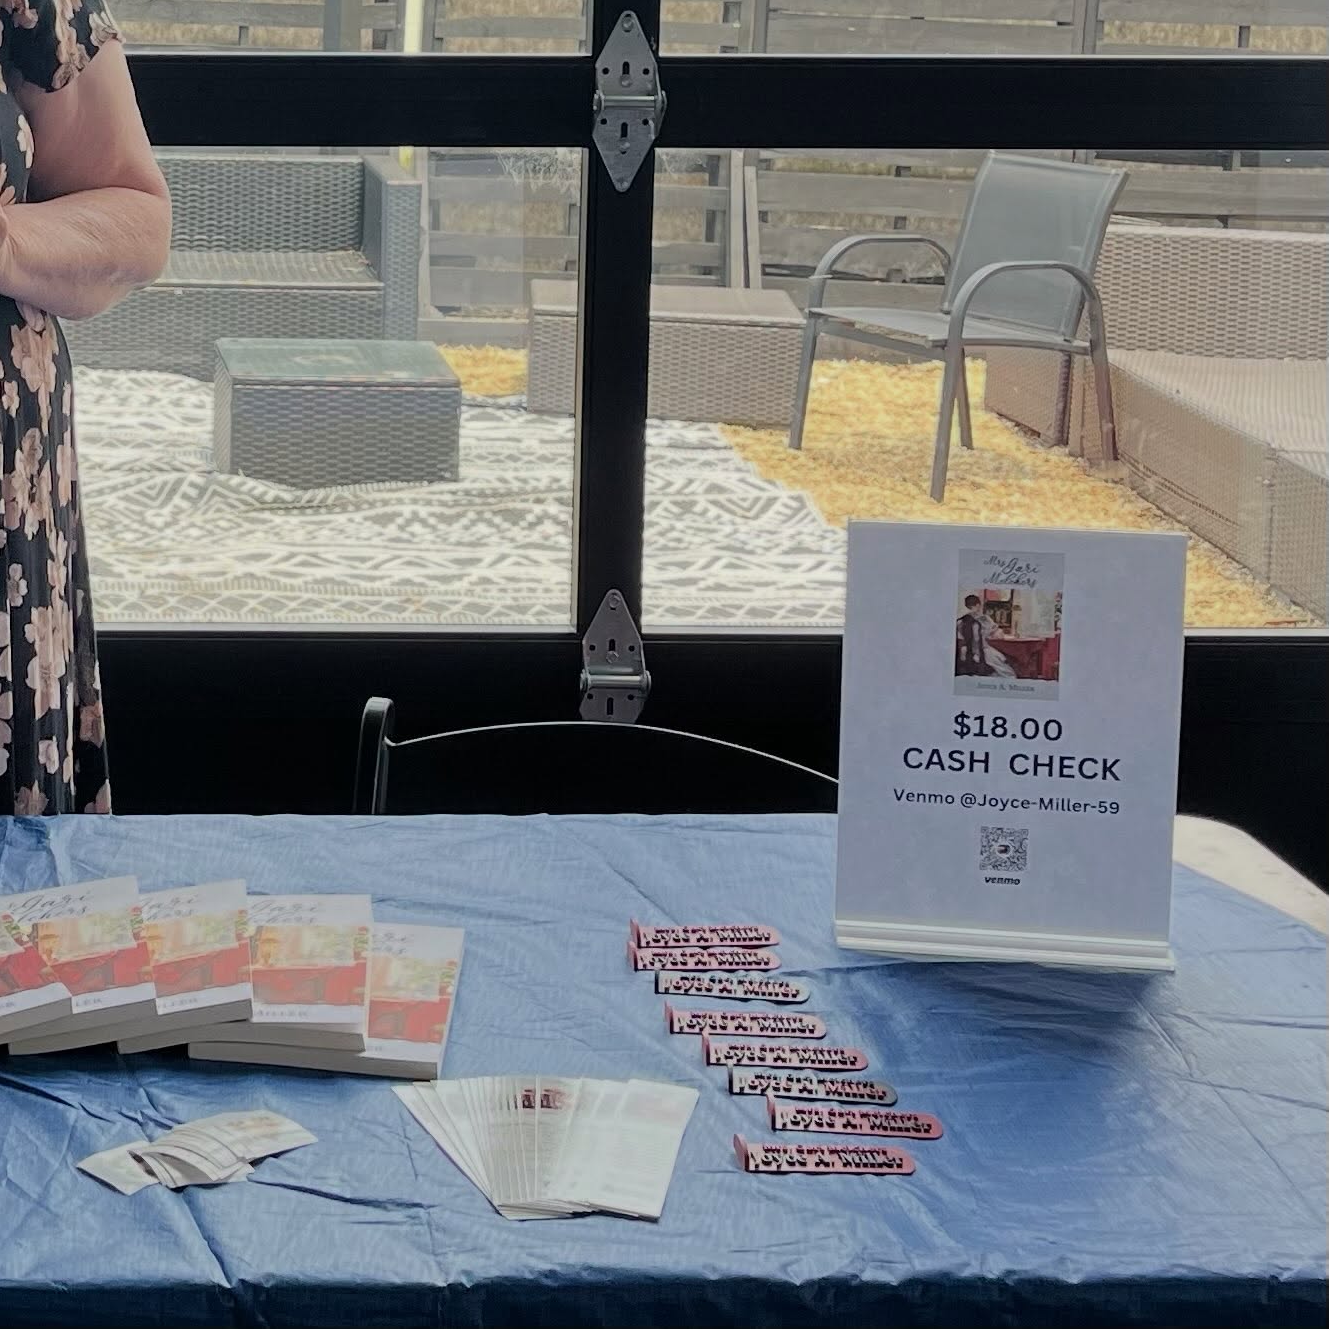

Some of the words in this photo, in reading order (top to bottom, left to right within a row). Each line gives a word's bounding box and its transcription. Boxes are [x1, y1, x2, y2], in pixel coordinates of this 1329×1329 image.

[953, 710, 1063, 742] $18.00
[903, 747, 990, 774] CASH
[1009, 753, 1121, 781] CHECK
[892, 788, 956, 805] Venmo
[960, 792, 1120, 815] @Joyce-Miller-59
